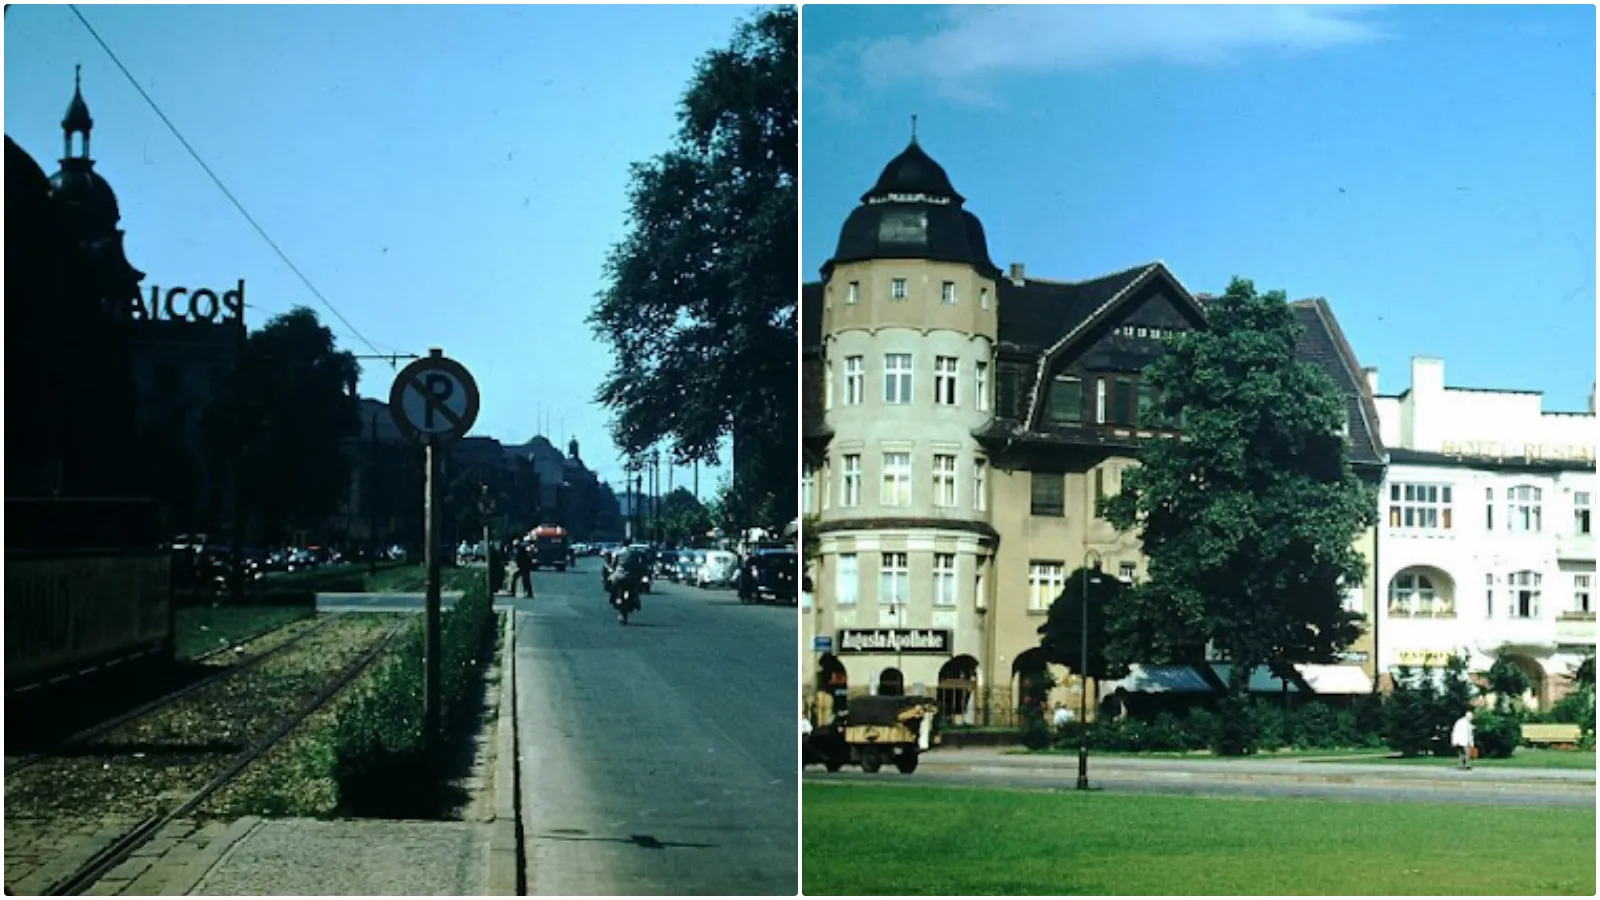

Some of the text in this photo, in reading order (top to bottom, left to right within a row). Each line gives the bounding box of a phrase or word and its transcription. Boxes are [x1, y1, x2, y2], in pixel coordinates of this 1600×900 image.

[426, 374, 452, 428] P
[1523, 443, 1596, 462] RESTA
[842, 630, 885, 651] Augusta
[887, 630, 944, 652] Apotheke
